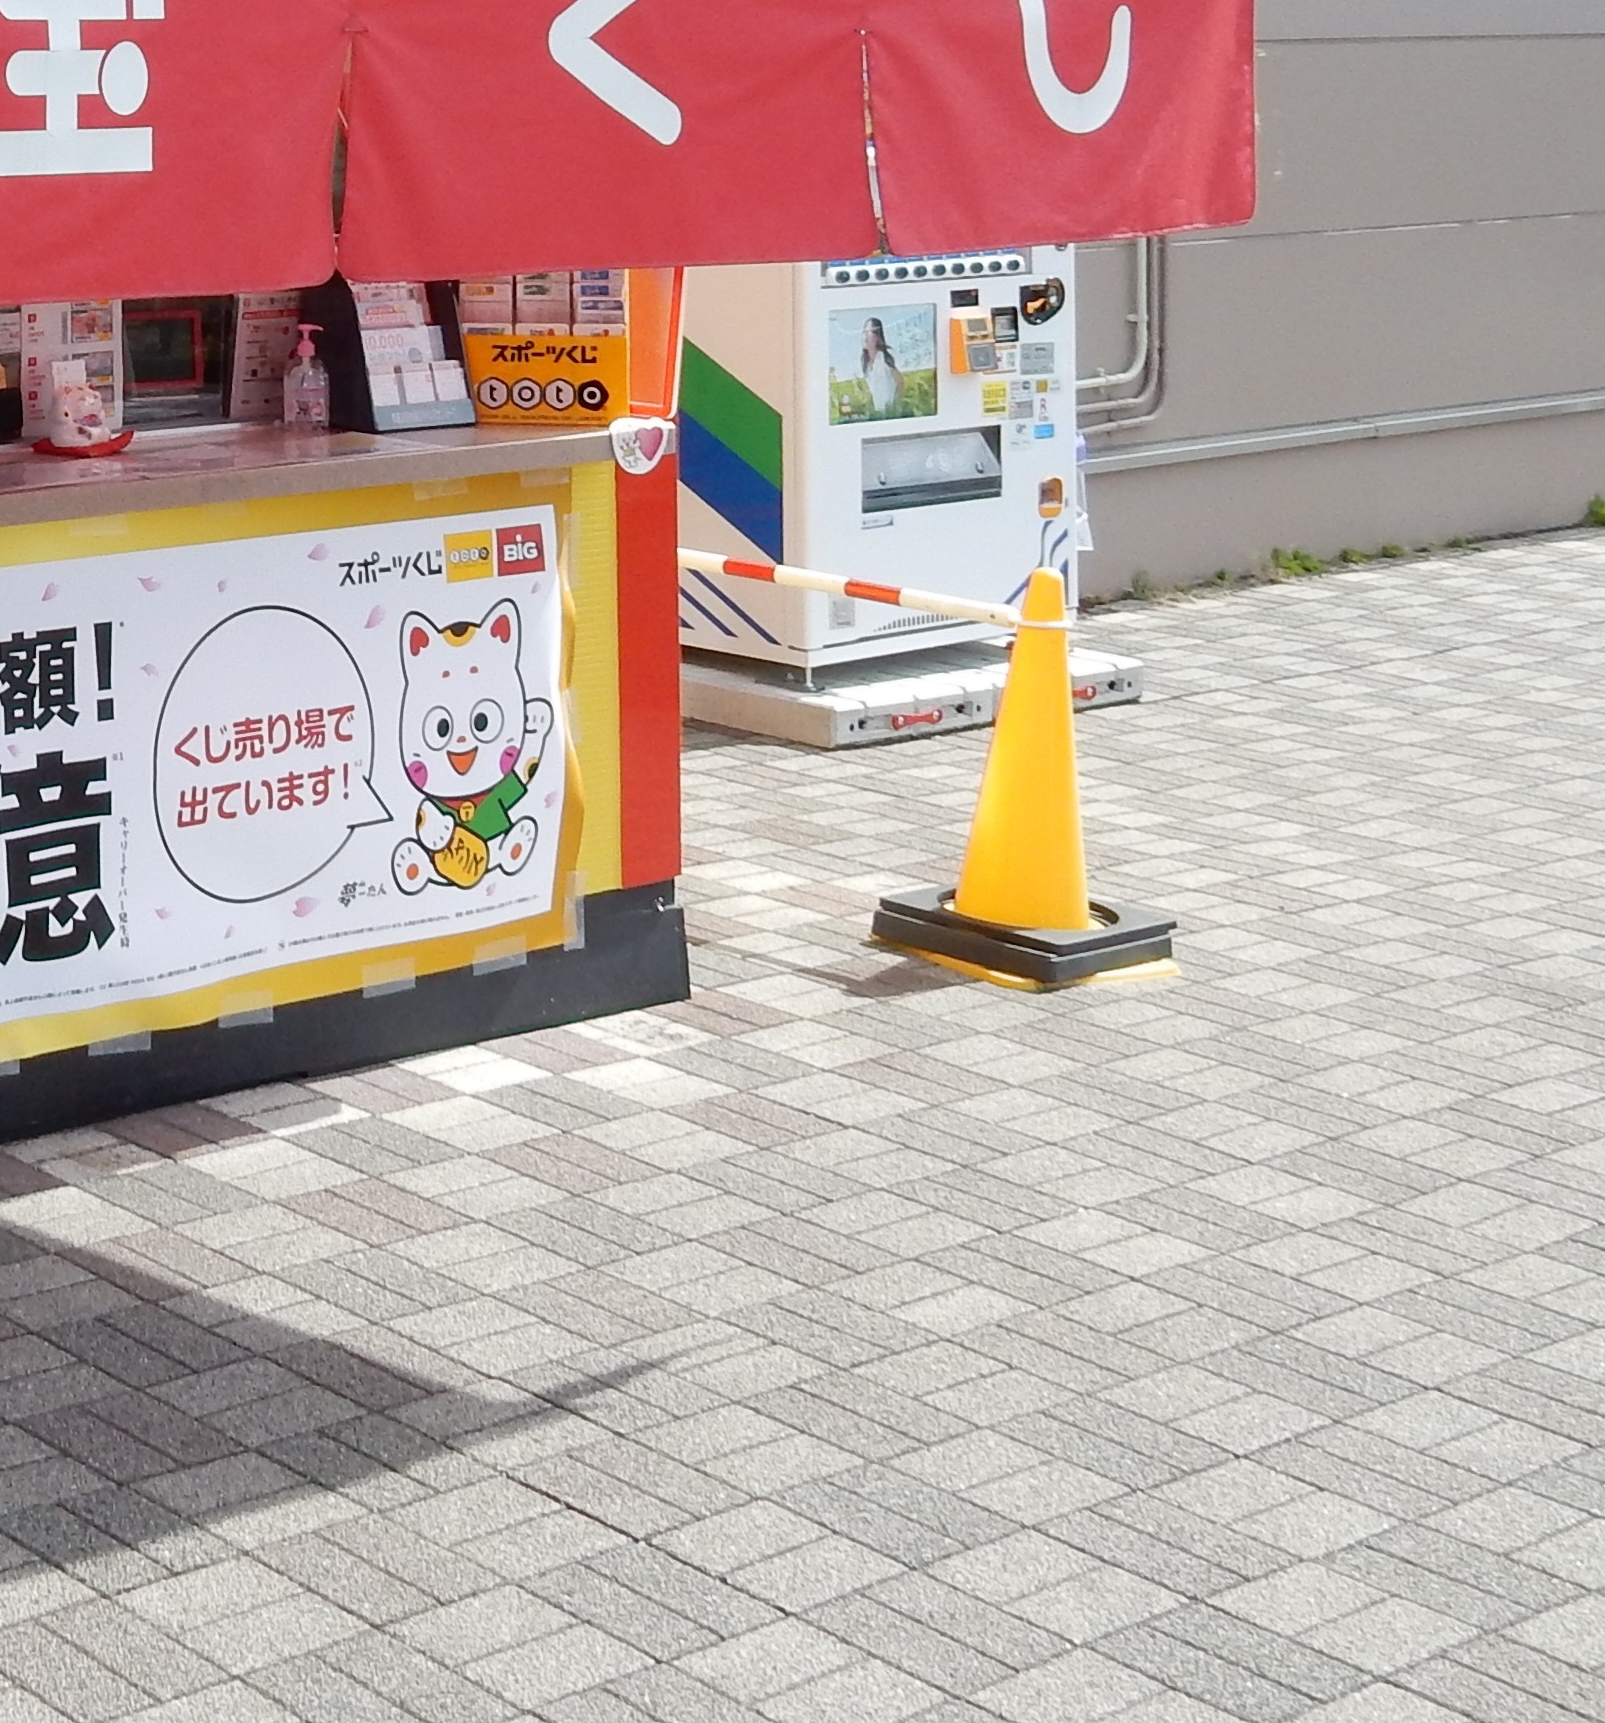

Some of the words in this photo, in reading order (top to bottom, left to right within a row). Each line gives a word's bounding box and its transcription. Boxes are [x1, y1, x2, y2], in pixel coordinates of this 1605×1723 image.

[491, 340, 599, 364] スポーツくじ
[477, 376, 610, 412] toto
[338, 550, 443, 586] スポーツくじ
[503, 533, 539, 563] BIG
[172, 705, 356, 766] くじ売り場で
[176, 762, 352, 828] 出ています!
